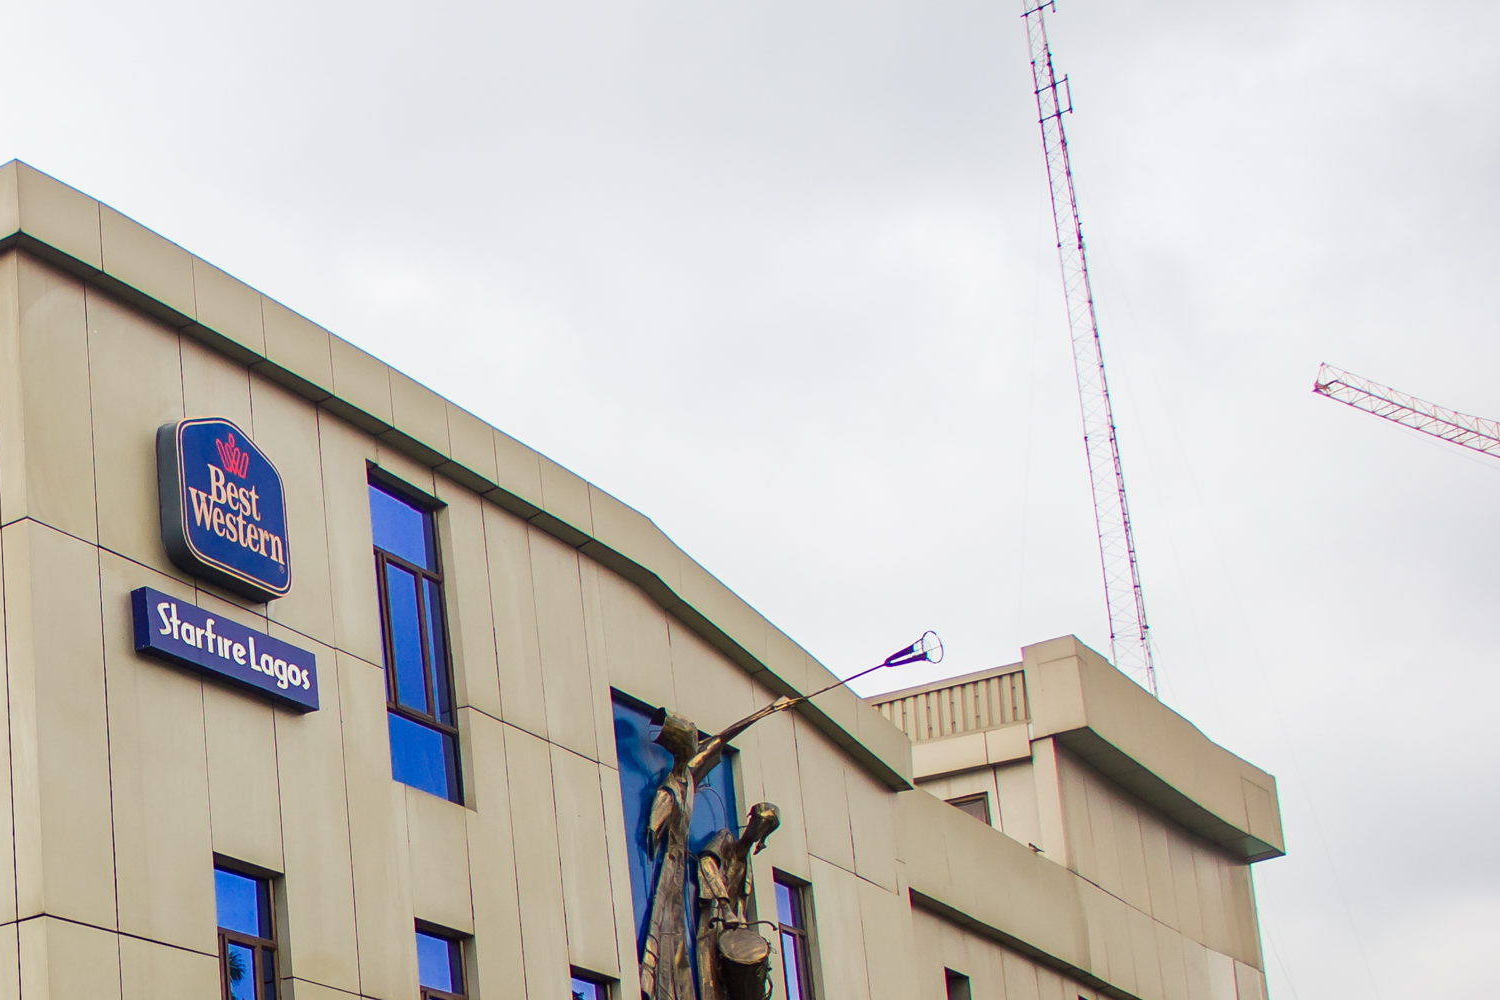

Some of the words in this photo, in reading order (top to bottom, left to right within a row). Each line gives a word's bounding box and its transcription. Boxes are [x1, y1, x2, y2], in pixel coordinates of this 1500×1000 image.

[188, 486, 285, 566] Western
[207, 463, 261, 522] Best
[156, 602, 247, 665] Starfire
[249, 636, 311, 691] Lagos
